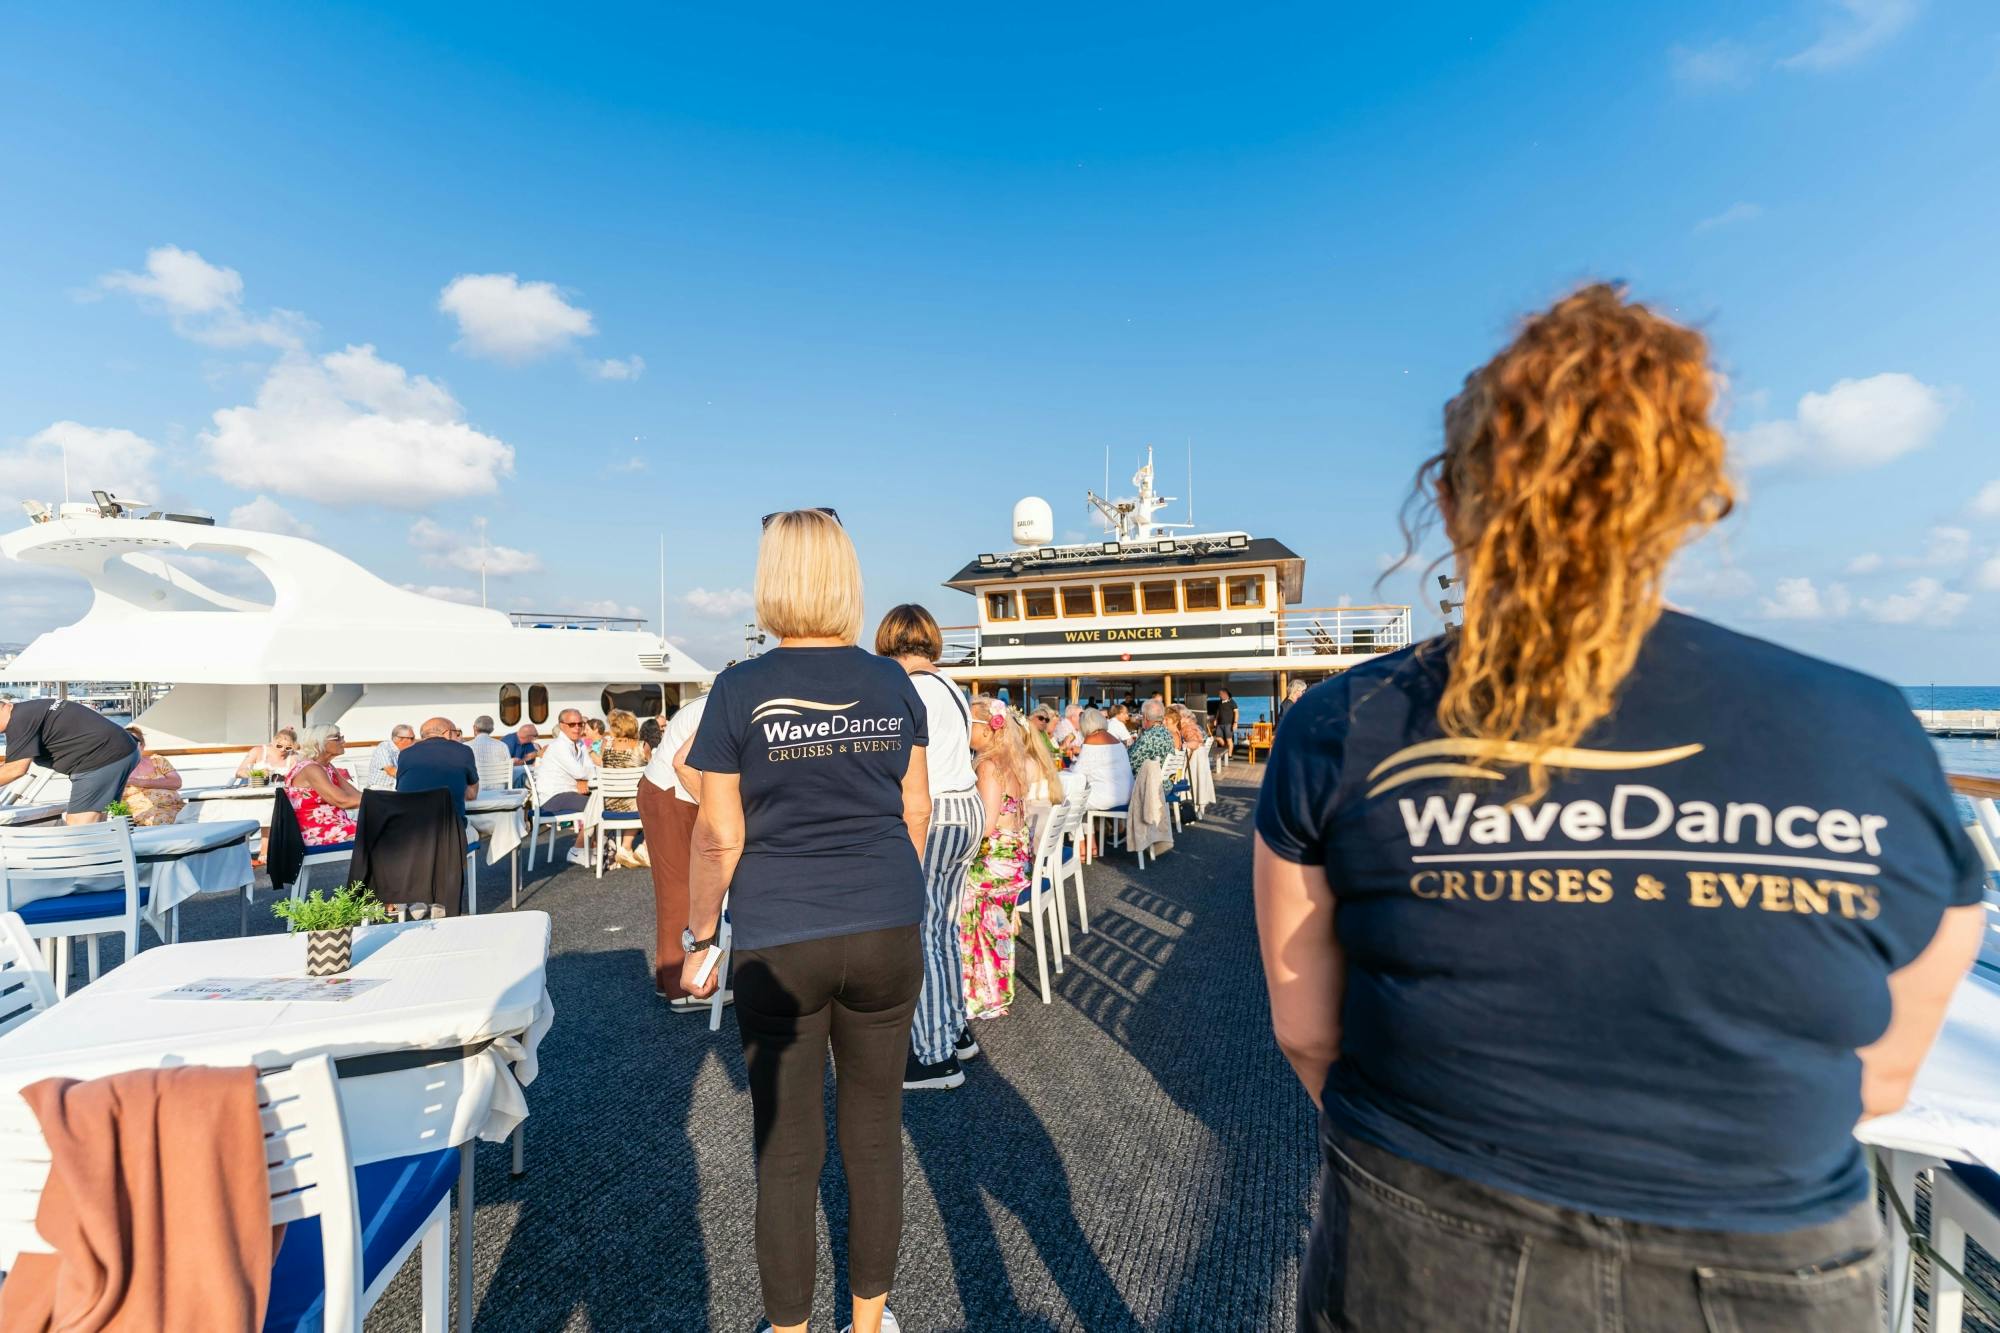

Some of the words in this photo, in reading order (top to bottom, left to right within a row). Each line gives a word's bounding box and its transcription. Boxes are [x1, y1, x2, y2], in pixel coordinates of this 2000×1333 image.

[1065, 631, 1100, 642] WAVE
[1107, 628, 1162, 640] DANCER
[1170, 627, 1179, 638] 1
[763, 715, 903, 743] WaveDancer
[768, 744, 833, 762] CRUISES
[839, 745, 848, 753] &
[853, 740, 902, 753] EVENTS
[1399, 784, 1888, 857] WaveDancer
[1410, 868, 1614, 904] CRUISES
[1633, 873, 1667, 901] &
[1686, 871, 1880, 920] EVENTS
